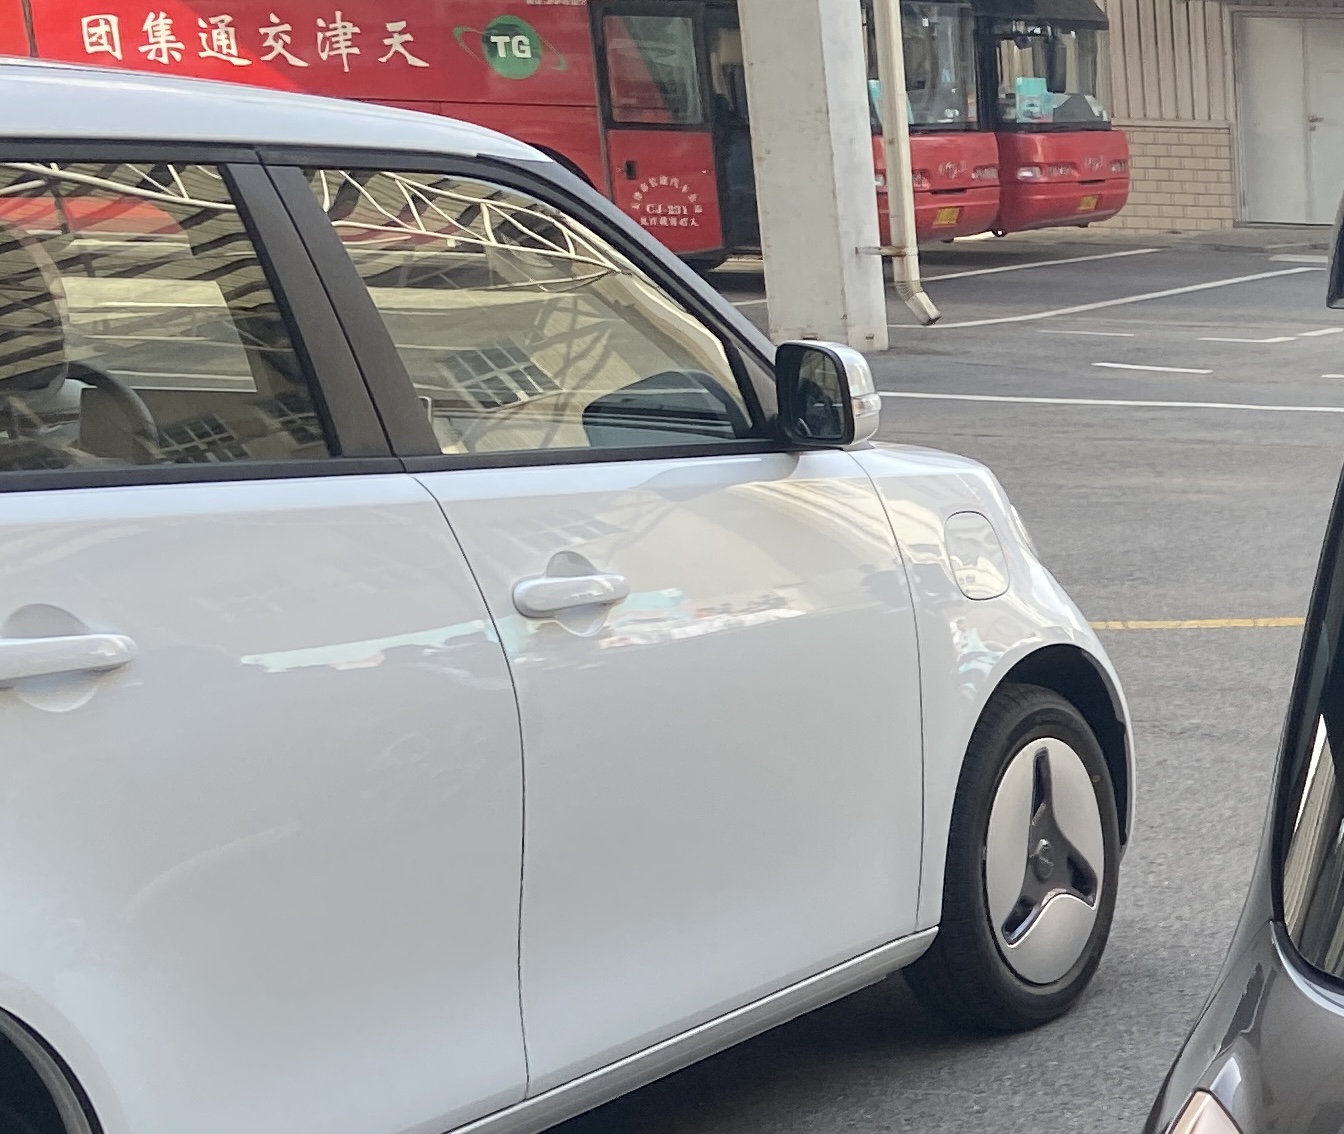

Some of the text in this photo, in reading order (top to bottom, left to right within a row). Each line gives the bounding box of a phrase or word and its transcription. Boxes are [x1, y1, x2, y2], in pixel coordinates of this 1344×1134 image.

[80, 11, 430, 73] 天津交通集团
[490, 35, 532, 59] TG
